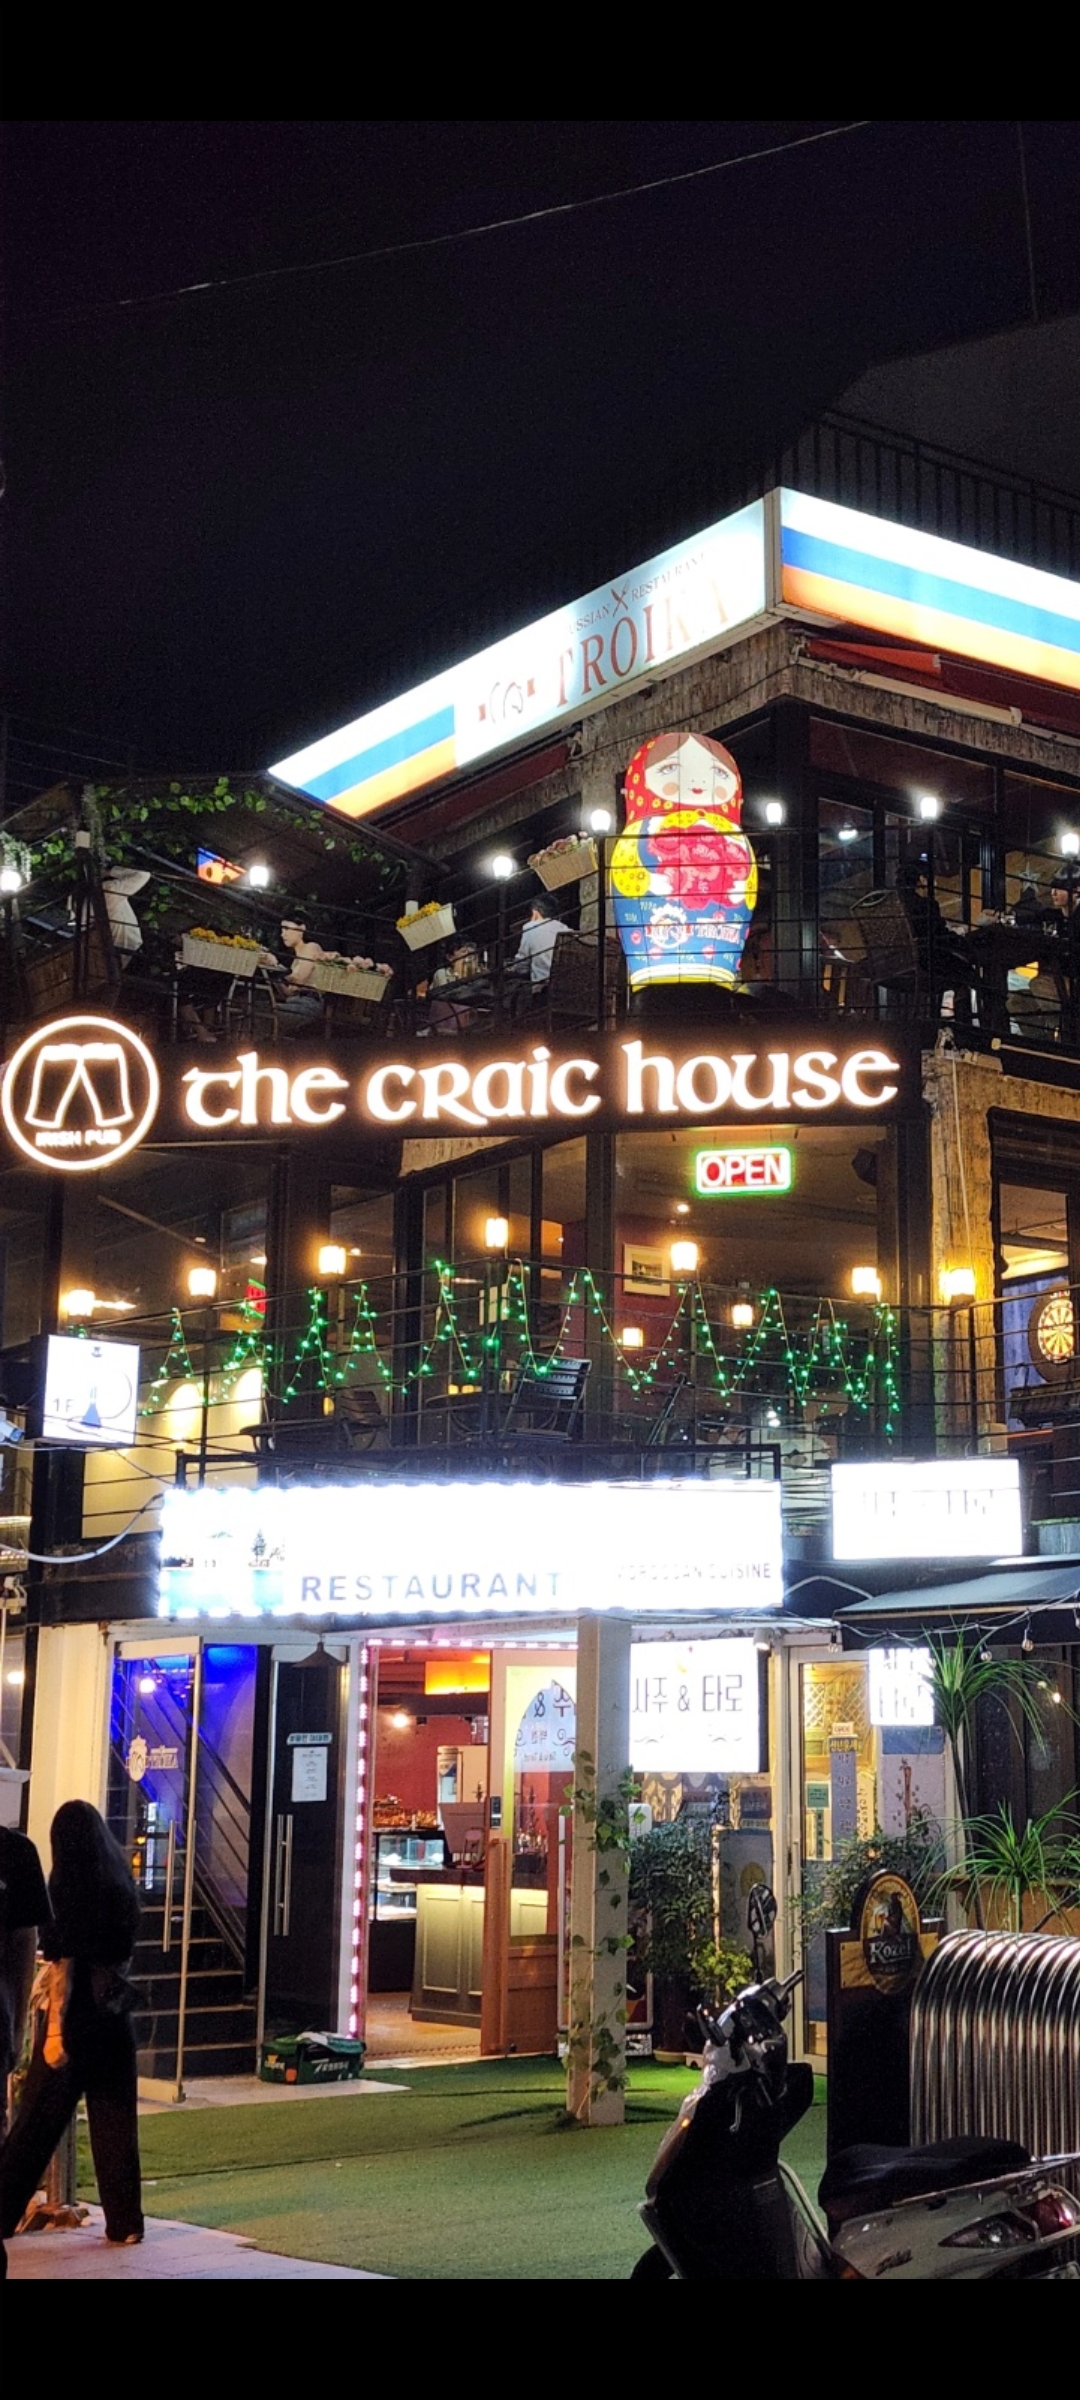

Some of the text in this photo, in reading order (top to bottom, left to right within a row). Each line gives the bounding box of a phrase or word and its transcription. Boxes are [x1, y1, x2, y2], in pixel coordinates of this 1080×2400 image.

[566, 602, 612, 636] USSIAN
[621, 1039, 901, 1114] house
[85, 1128, 122, 1146] PUB
[702, 1153, 786, 1188] OPEN
[709, 1561, 772, 1580] CUISINE
[300, 1572, 561, 1602] RESTAURANT
[632, 1673, 744, 1714] 사주 & 타로
[868, 1940, 912, 1964] Kozel
